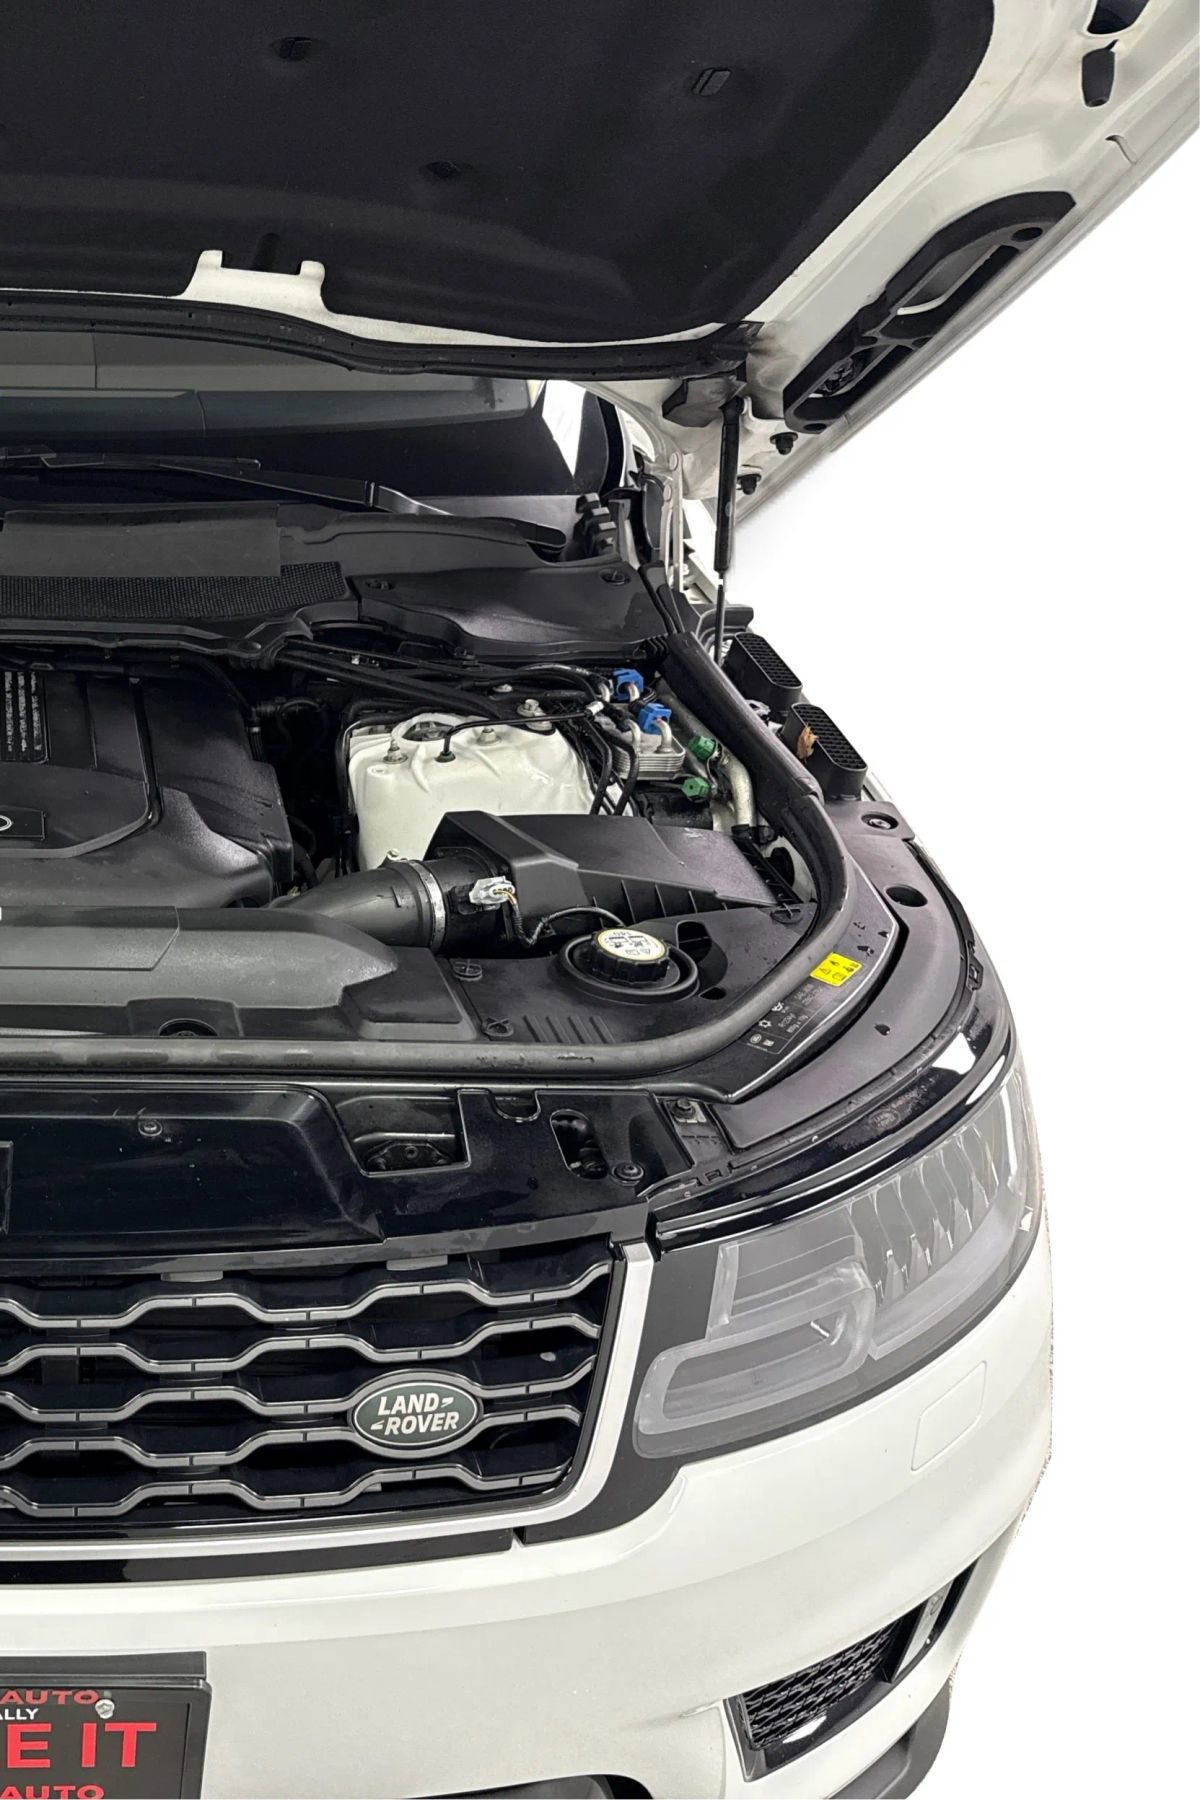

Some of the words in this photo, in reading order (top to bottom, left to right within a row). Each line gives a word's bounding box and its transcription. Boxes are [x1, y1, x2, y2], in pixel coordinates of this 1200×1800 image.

[378, 1392, 439, 1416] LAND
[384, 1411, 460, 1436] ROVER
[81, 1722, 157, 1768] IT
